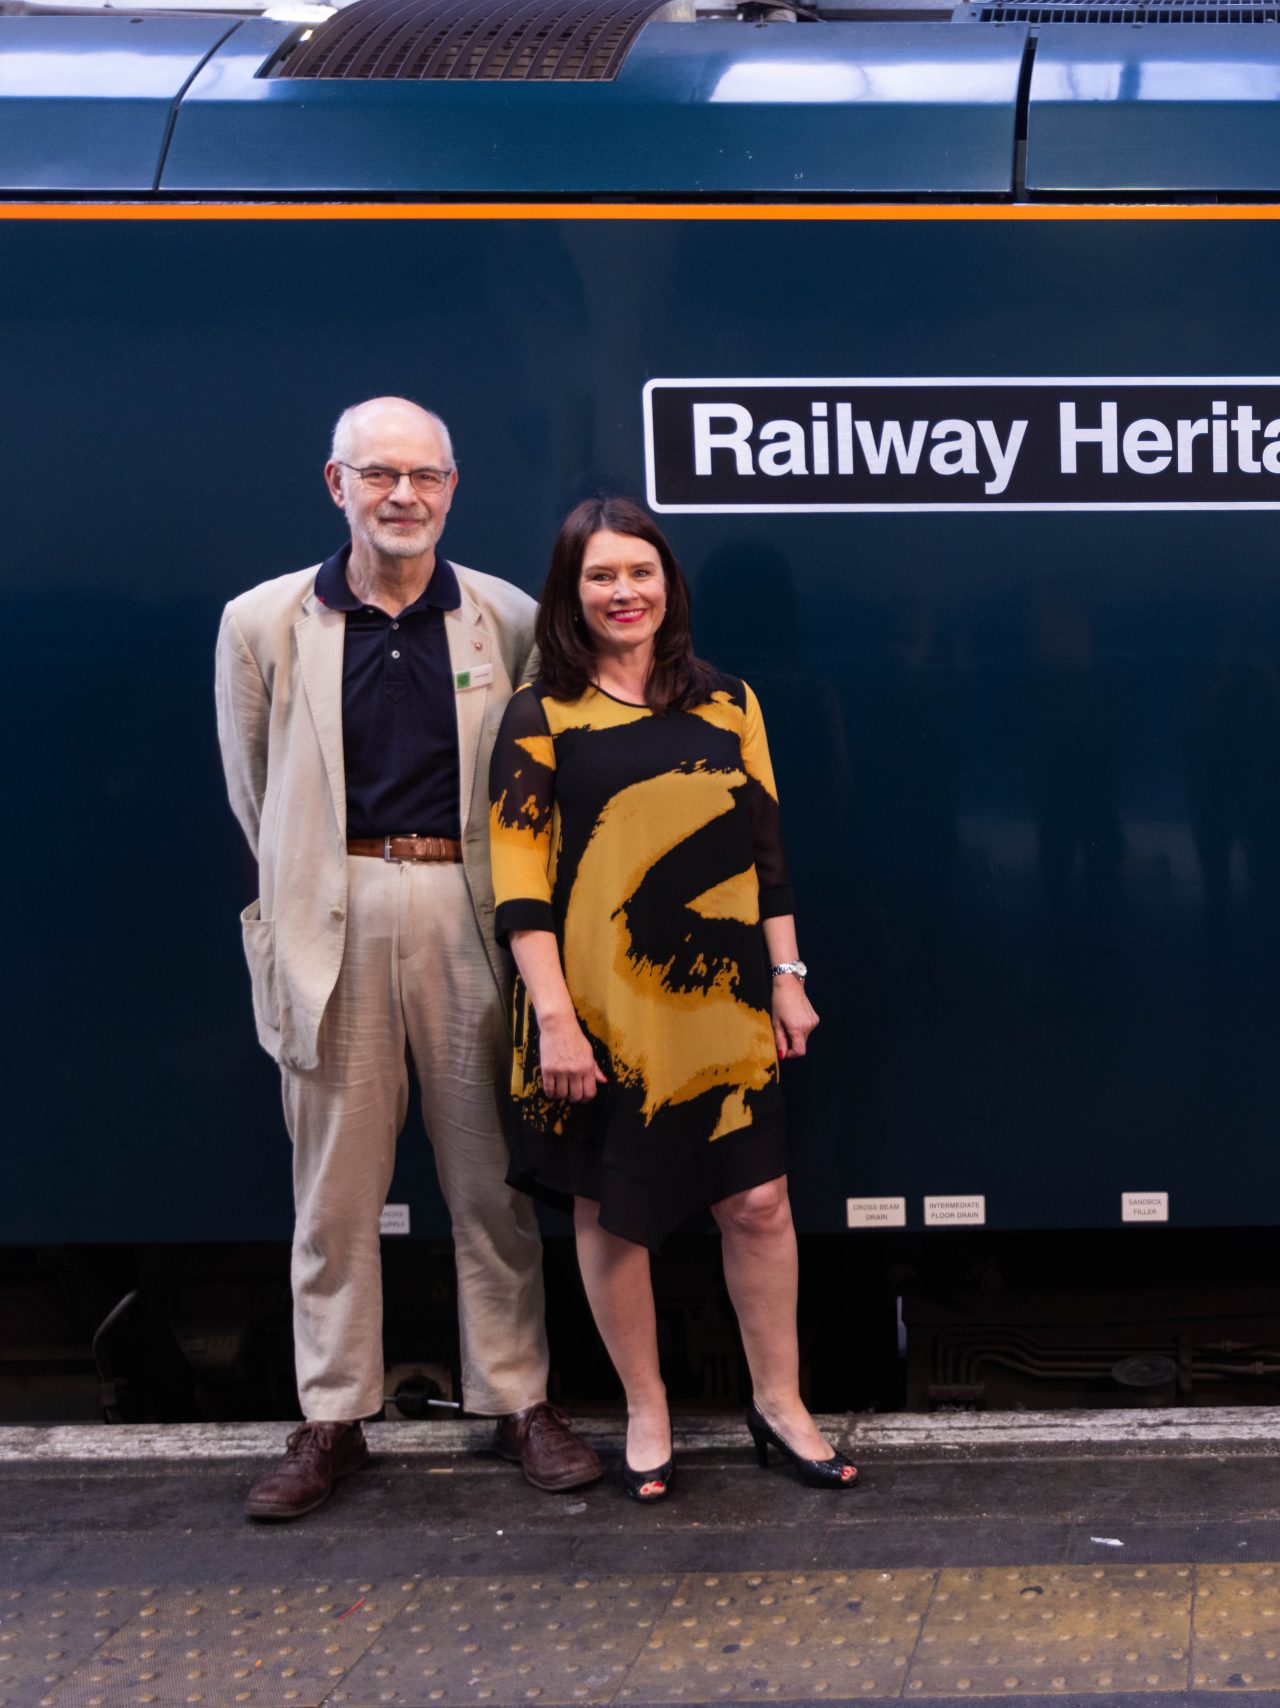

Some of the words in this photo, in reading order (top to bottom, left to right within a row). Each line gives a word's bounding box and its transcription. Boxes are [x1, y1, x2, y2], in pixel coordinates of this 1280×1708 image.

[692, 402, 1029, 496] Railway
[929, 1201, 980, 1209] INTERMEDIATE
[865, 1213, 888, 1221] DRAIN
[956, 1211, 979, 1219] DRAIN
